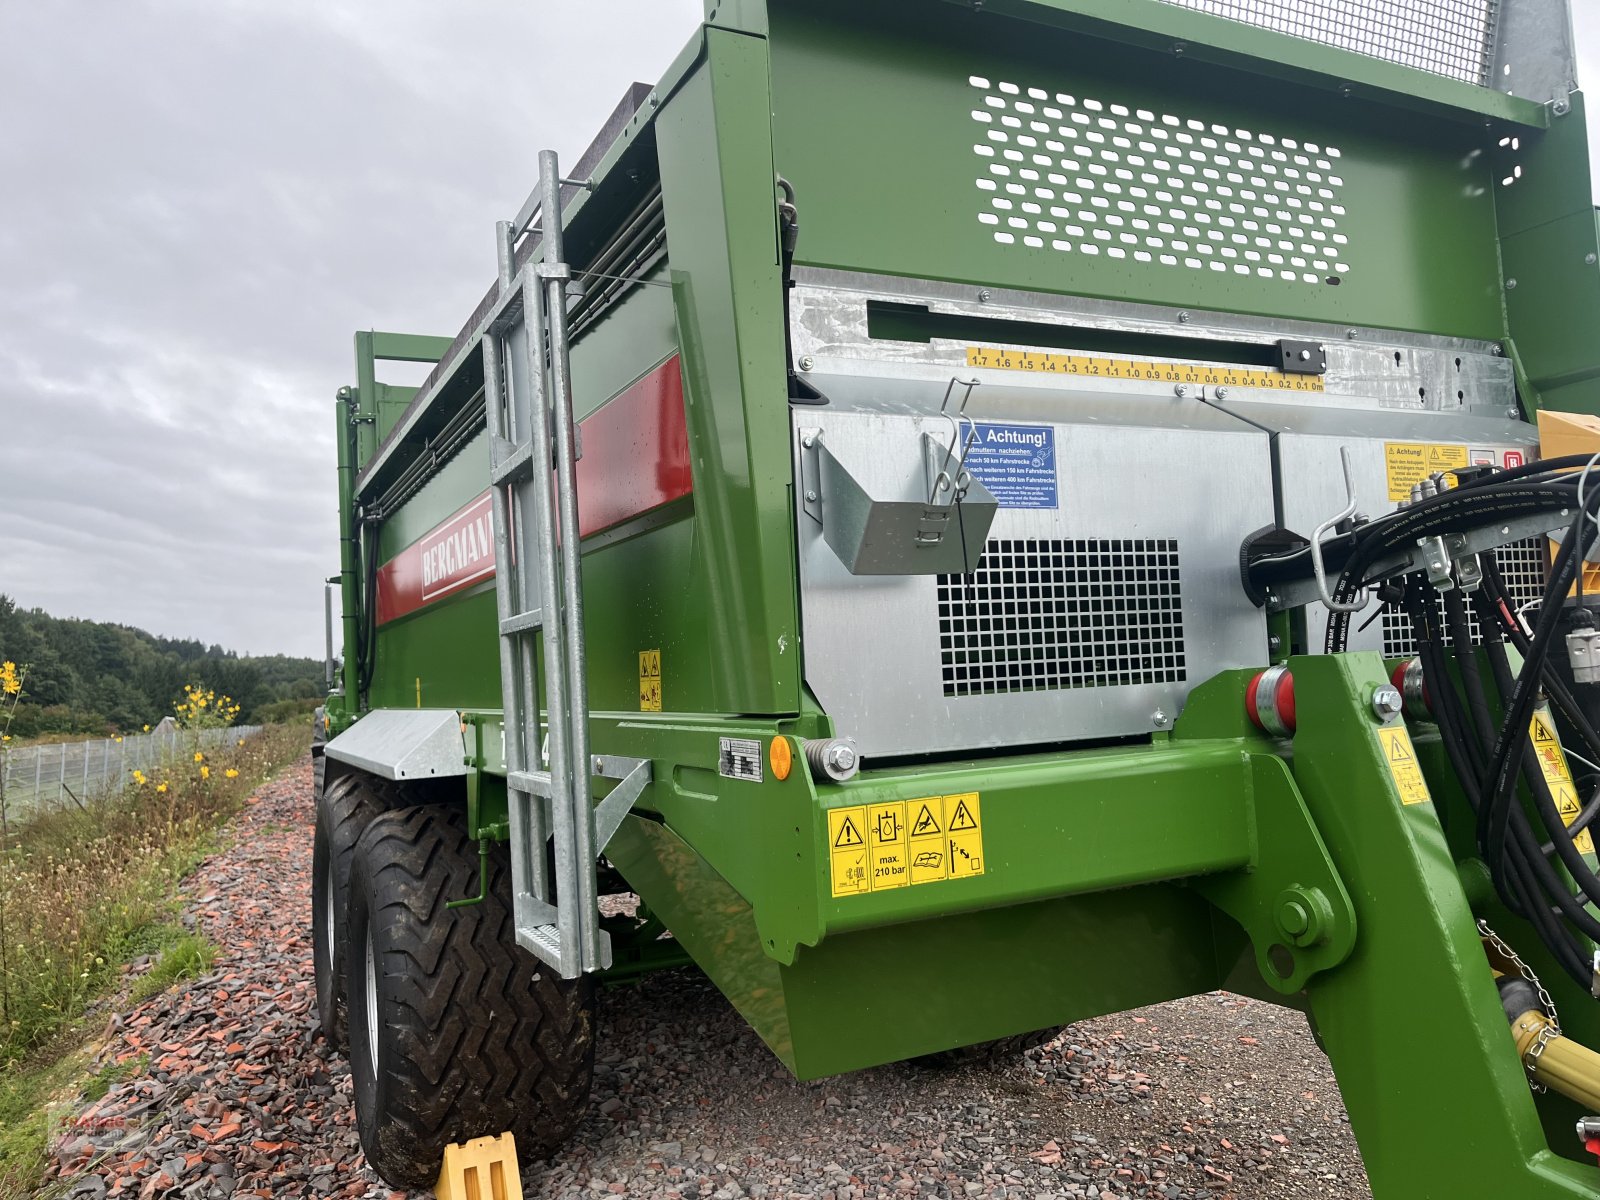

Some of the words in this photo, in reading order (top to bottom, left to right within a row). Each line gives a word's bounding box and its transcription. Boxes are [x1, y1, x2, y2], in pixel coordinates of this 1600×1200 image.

[973, 356, 987, 365] 1.7
[996, 359, 1010, 367] 1.6
[1019, 360, 1033, 369] 1.5
[1041, 362, 1055, 371] 1.4
[1063, 364, 1077, 372] 1.3
[1085, 366, 1098, 374] 1.2
[1106, 367, 1118, 375] 1.1
[1126, 369, 1140, 377] 1.0
[1167, 372, 1179, 380] 0.8
[1224, 376, 1236, 384] 0.5
[1243, 378, 1255, 386] 0.4
[1261, 379, 1273, 387] 0.3
[987, 429, 1046, 447] Achtung!
[1397, 448, 1421, 456] Achtung!
[1510, 458, 1517, 467] B
[880, 855, 899, 864] max.
[875, 868, 890, 877] 210
[892, 866, 906, 875] bar
